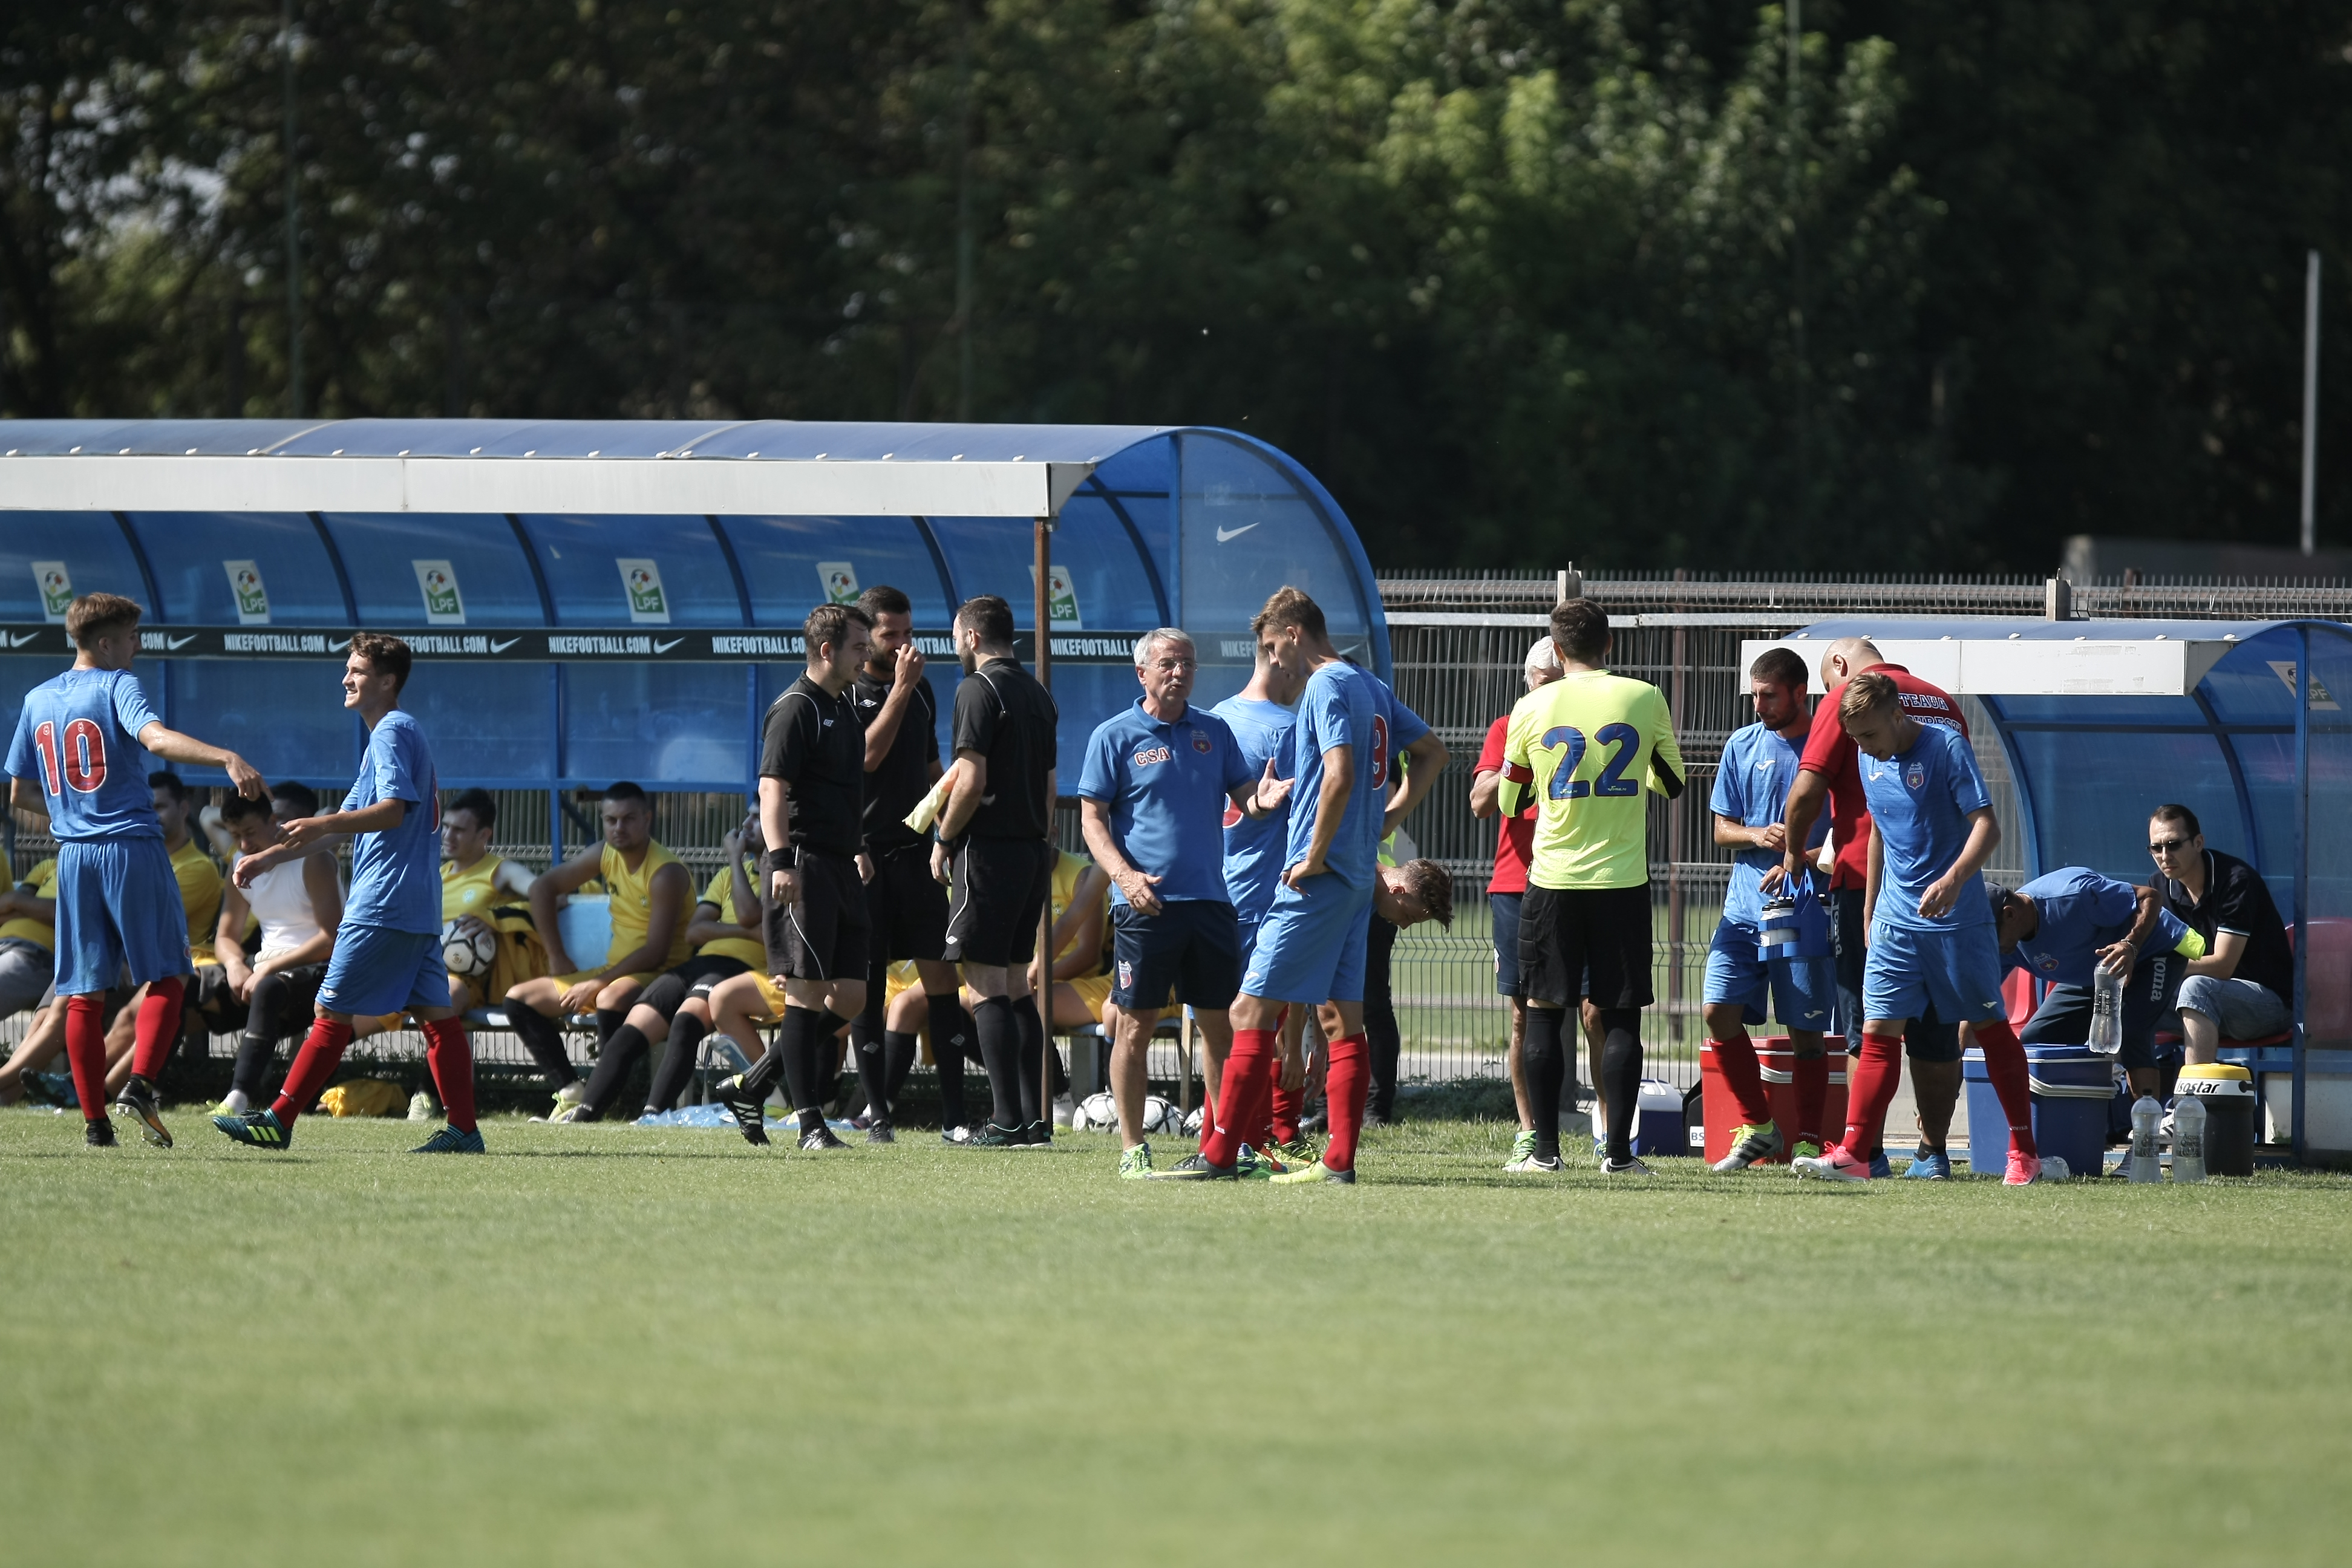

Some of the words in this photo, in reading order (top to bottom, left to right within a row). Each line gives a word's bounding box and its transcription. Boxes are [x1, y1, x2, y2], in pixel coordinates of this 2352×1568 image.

[243, 598, 265, 612] LPF
[431, 598, 454, 612] LPF
[635, 596, 659, 610] LPF
[1050, 604, 1072, 618] LPF
[224, 634, 325, 653] NIKEFOOTBALL.COM
[548, 636, 650, 654] NIKEFOOTBALL.COM
[711, 636, 806, 654] NIKEFOOTBALL.CO
[1898, 693, 1949, 711] TEAUA
[2309, 689, 2328, 700] PF
[34, 718, 107, 796] 10
[1134, 747, 1171, 766] CSA
[1541, 722, 1640, 800] 22
[2176, 1080, 2220, 1094] isostar
